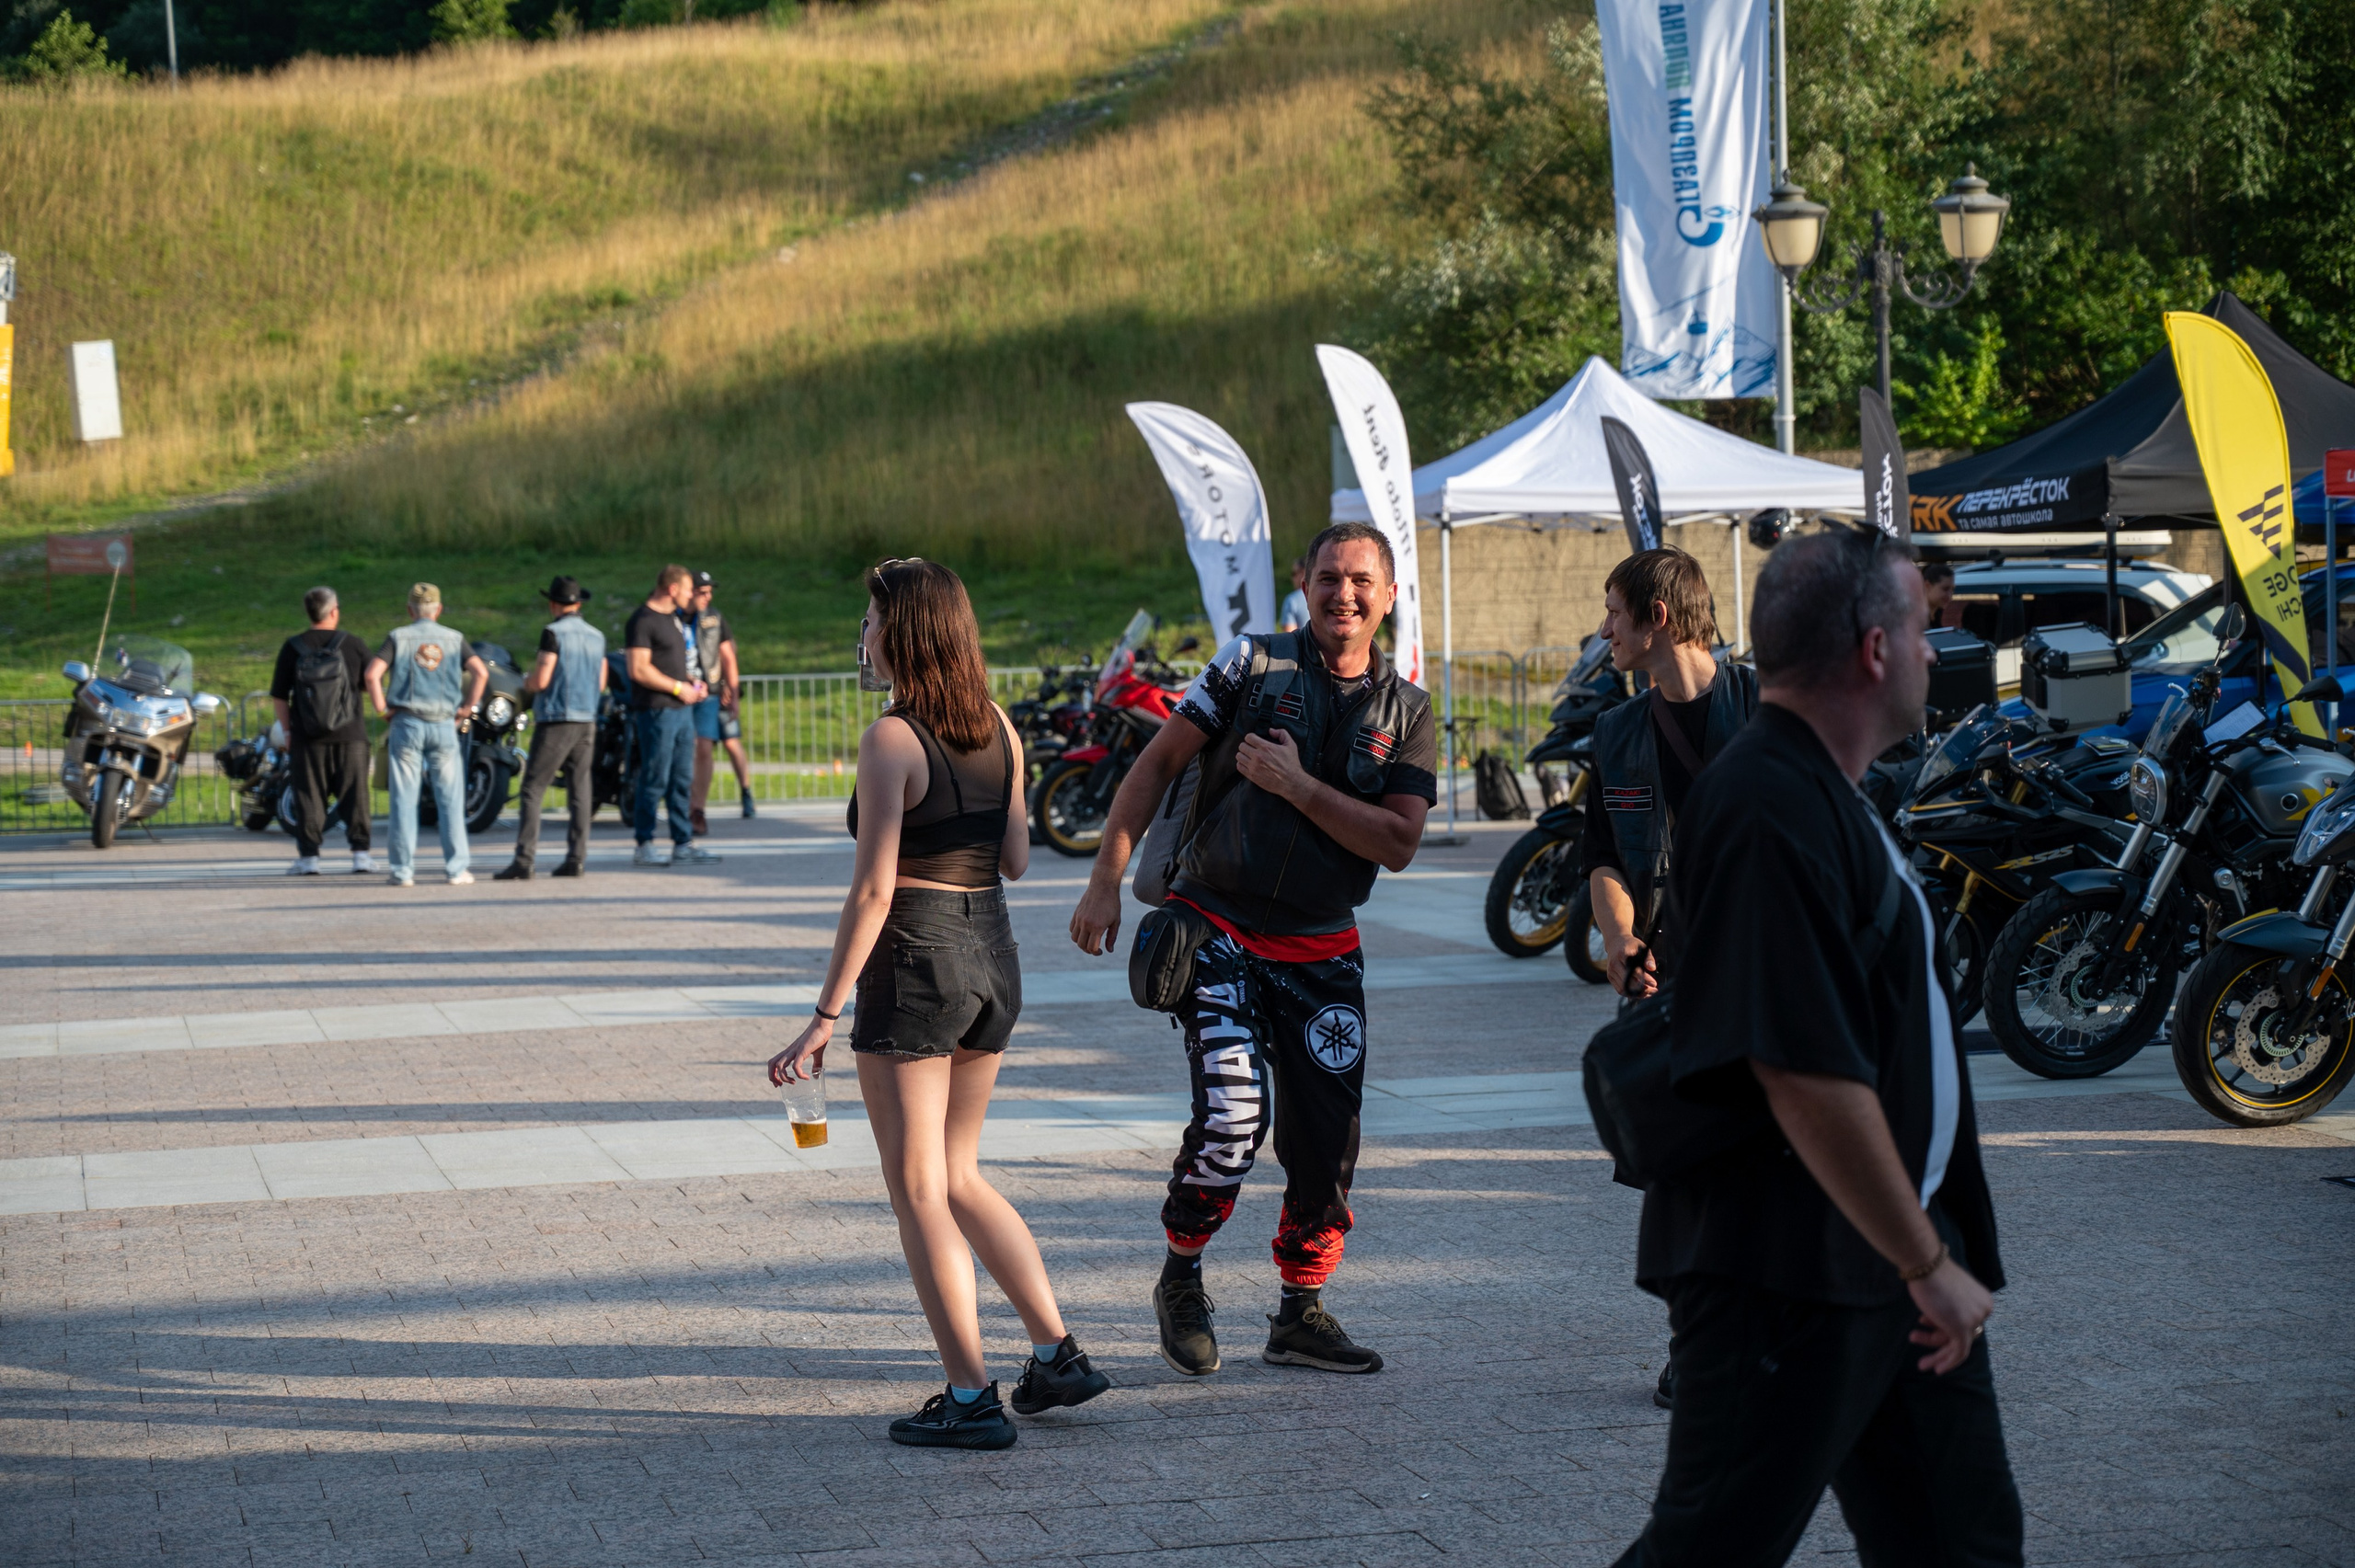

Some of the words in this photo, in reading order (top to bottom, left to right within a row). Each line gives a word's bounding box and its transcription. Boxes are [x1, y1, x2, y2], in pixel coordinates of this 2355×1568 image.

[1957, 476, 2070, 513] ПЕРЕКРЁСТОК
[1970, 516, 1998, 530] самая
[2001, 508, 2053, 527] автошкола
[1371, 730, 1393, 746] RUSSIA
[1182, 982, 1263, 1187] YAMAHA
